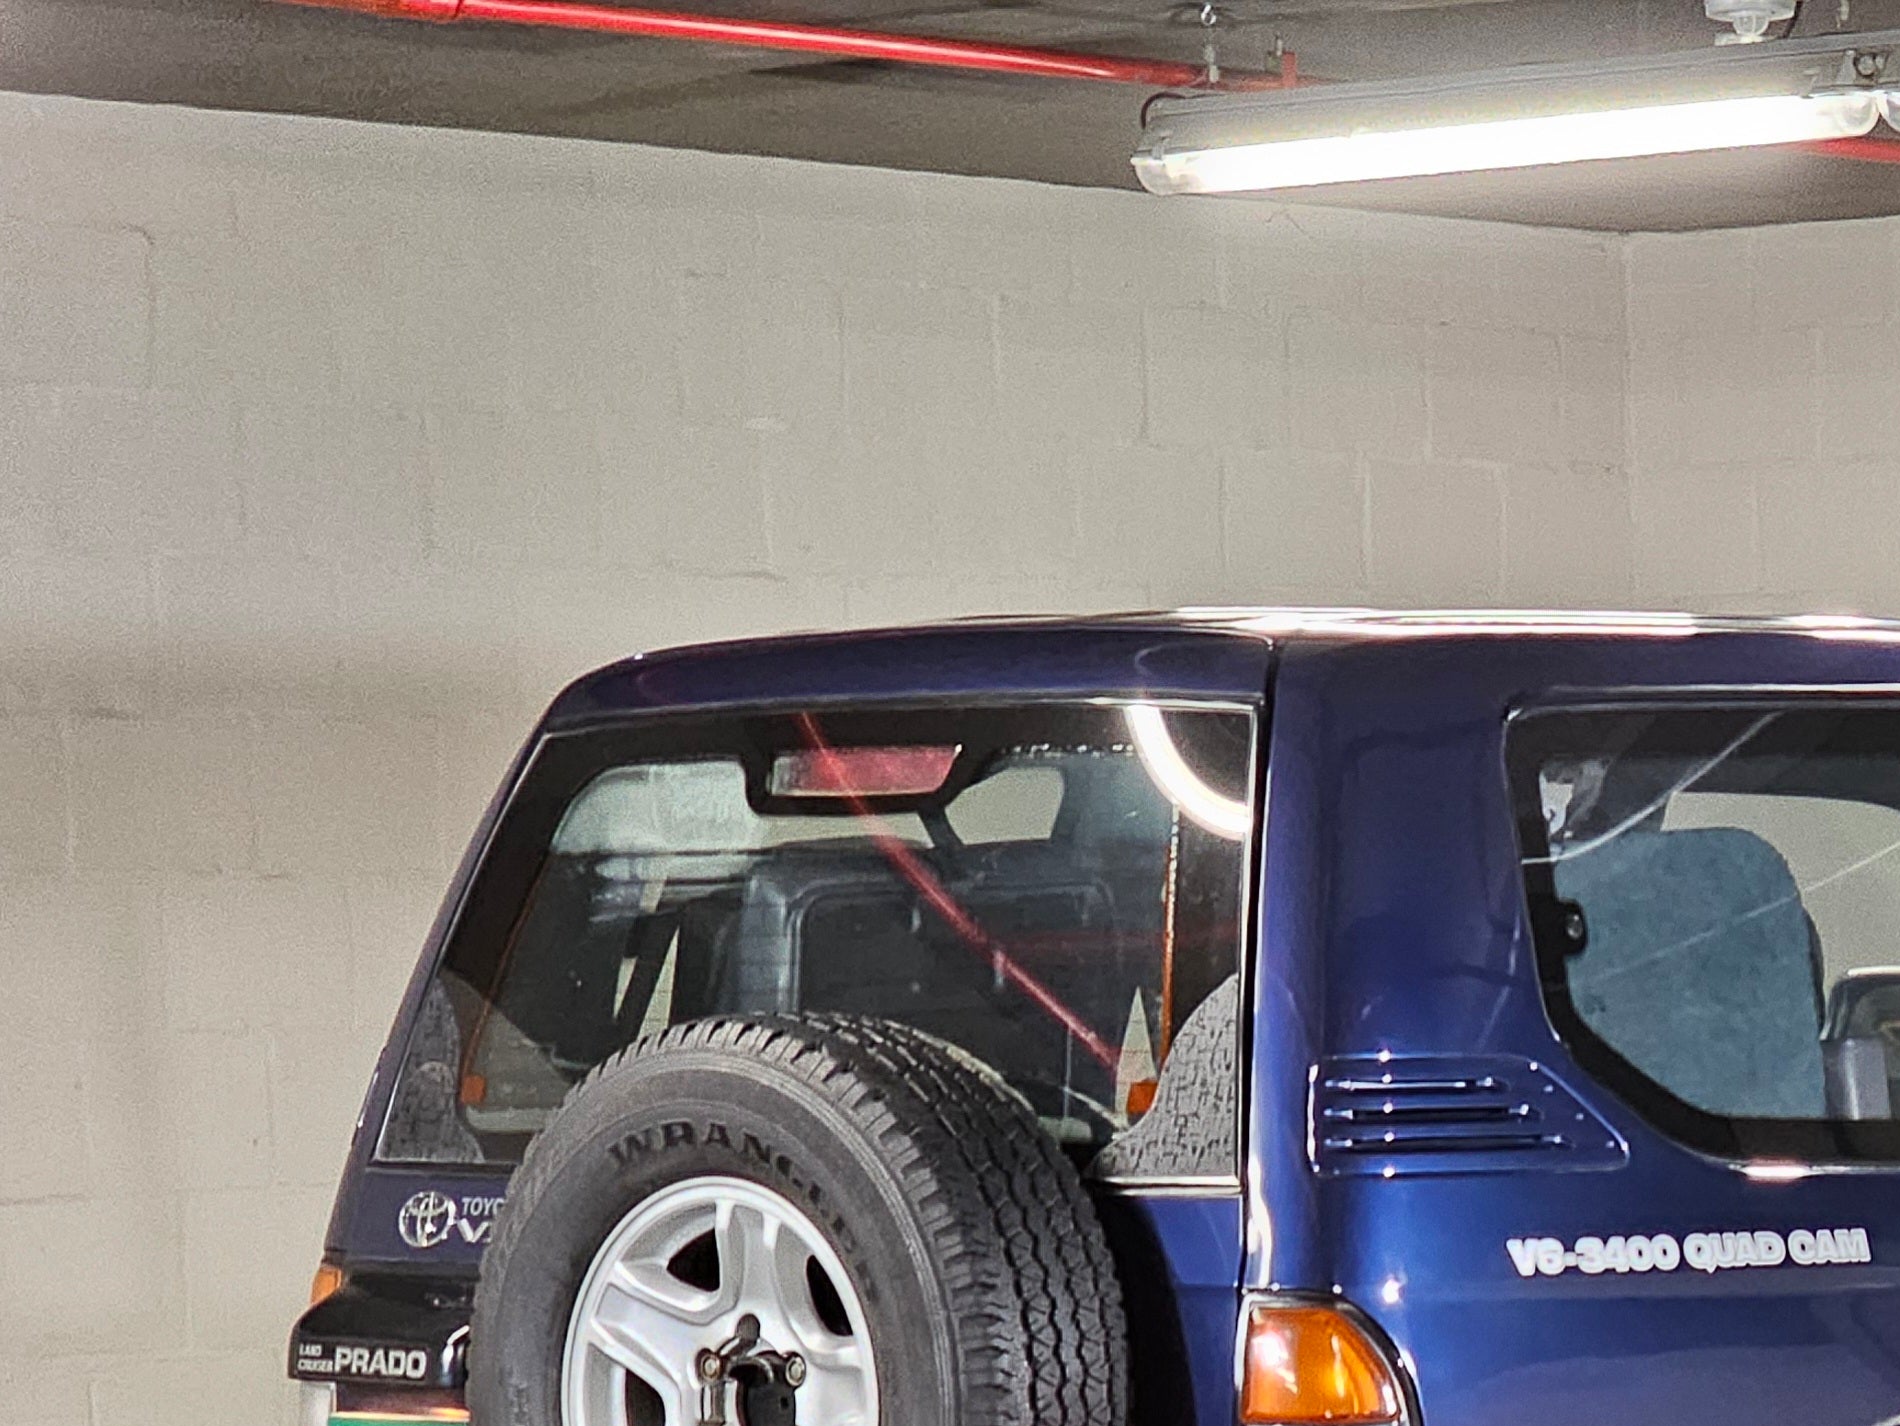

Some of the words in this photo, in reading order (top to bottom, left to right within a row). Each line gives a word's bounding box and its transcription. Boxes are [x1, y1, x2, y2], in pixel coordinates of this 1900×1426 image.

[461, 1197, 506, 1216] TOYO
[1506, 1234, 1680, 1277] V6-3400
[1683, 1231, 1786, 1274] QUAD
[1787, 1227, 1872, 1264] CAM
[335, 1345, 427, 1379] PRADO
